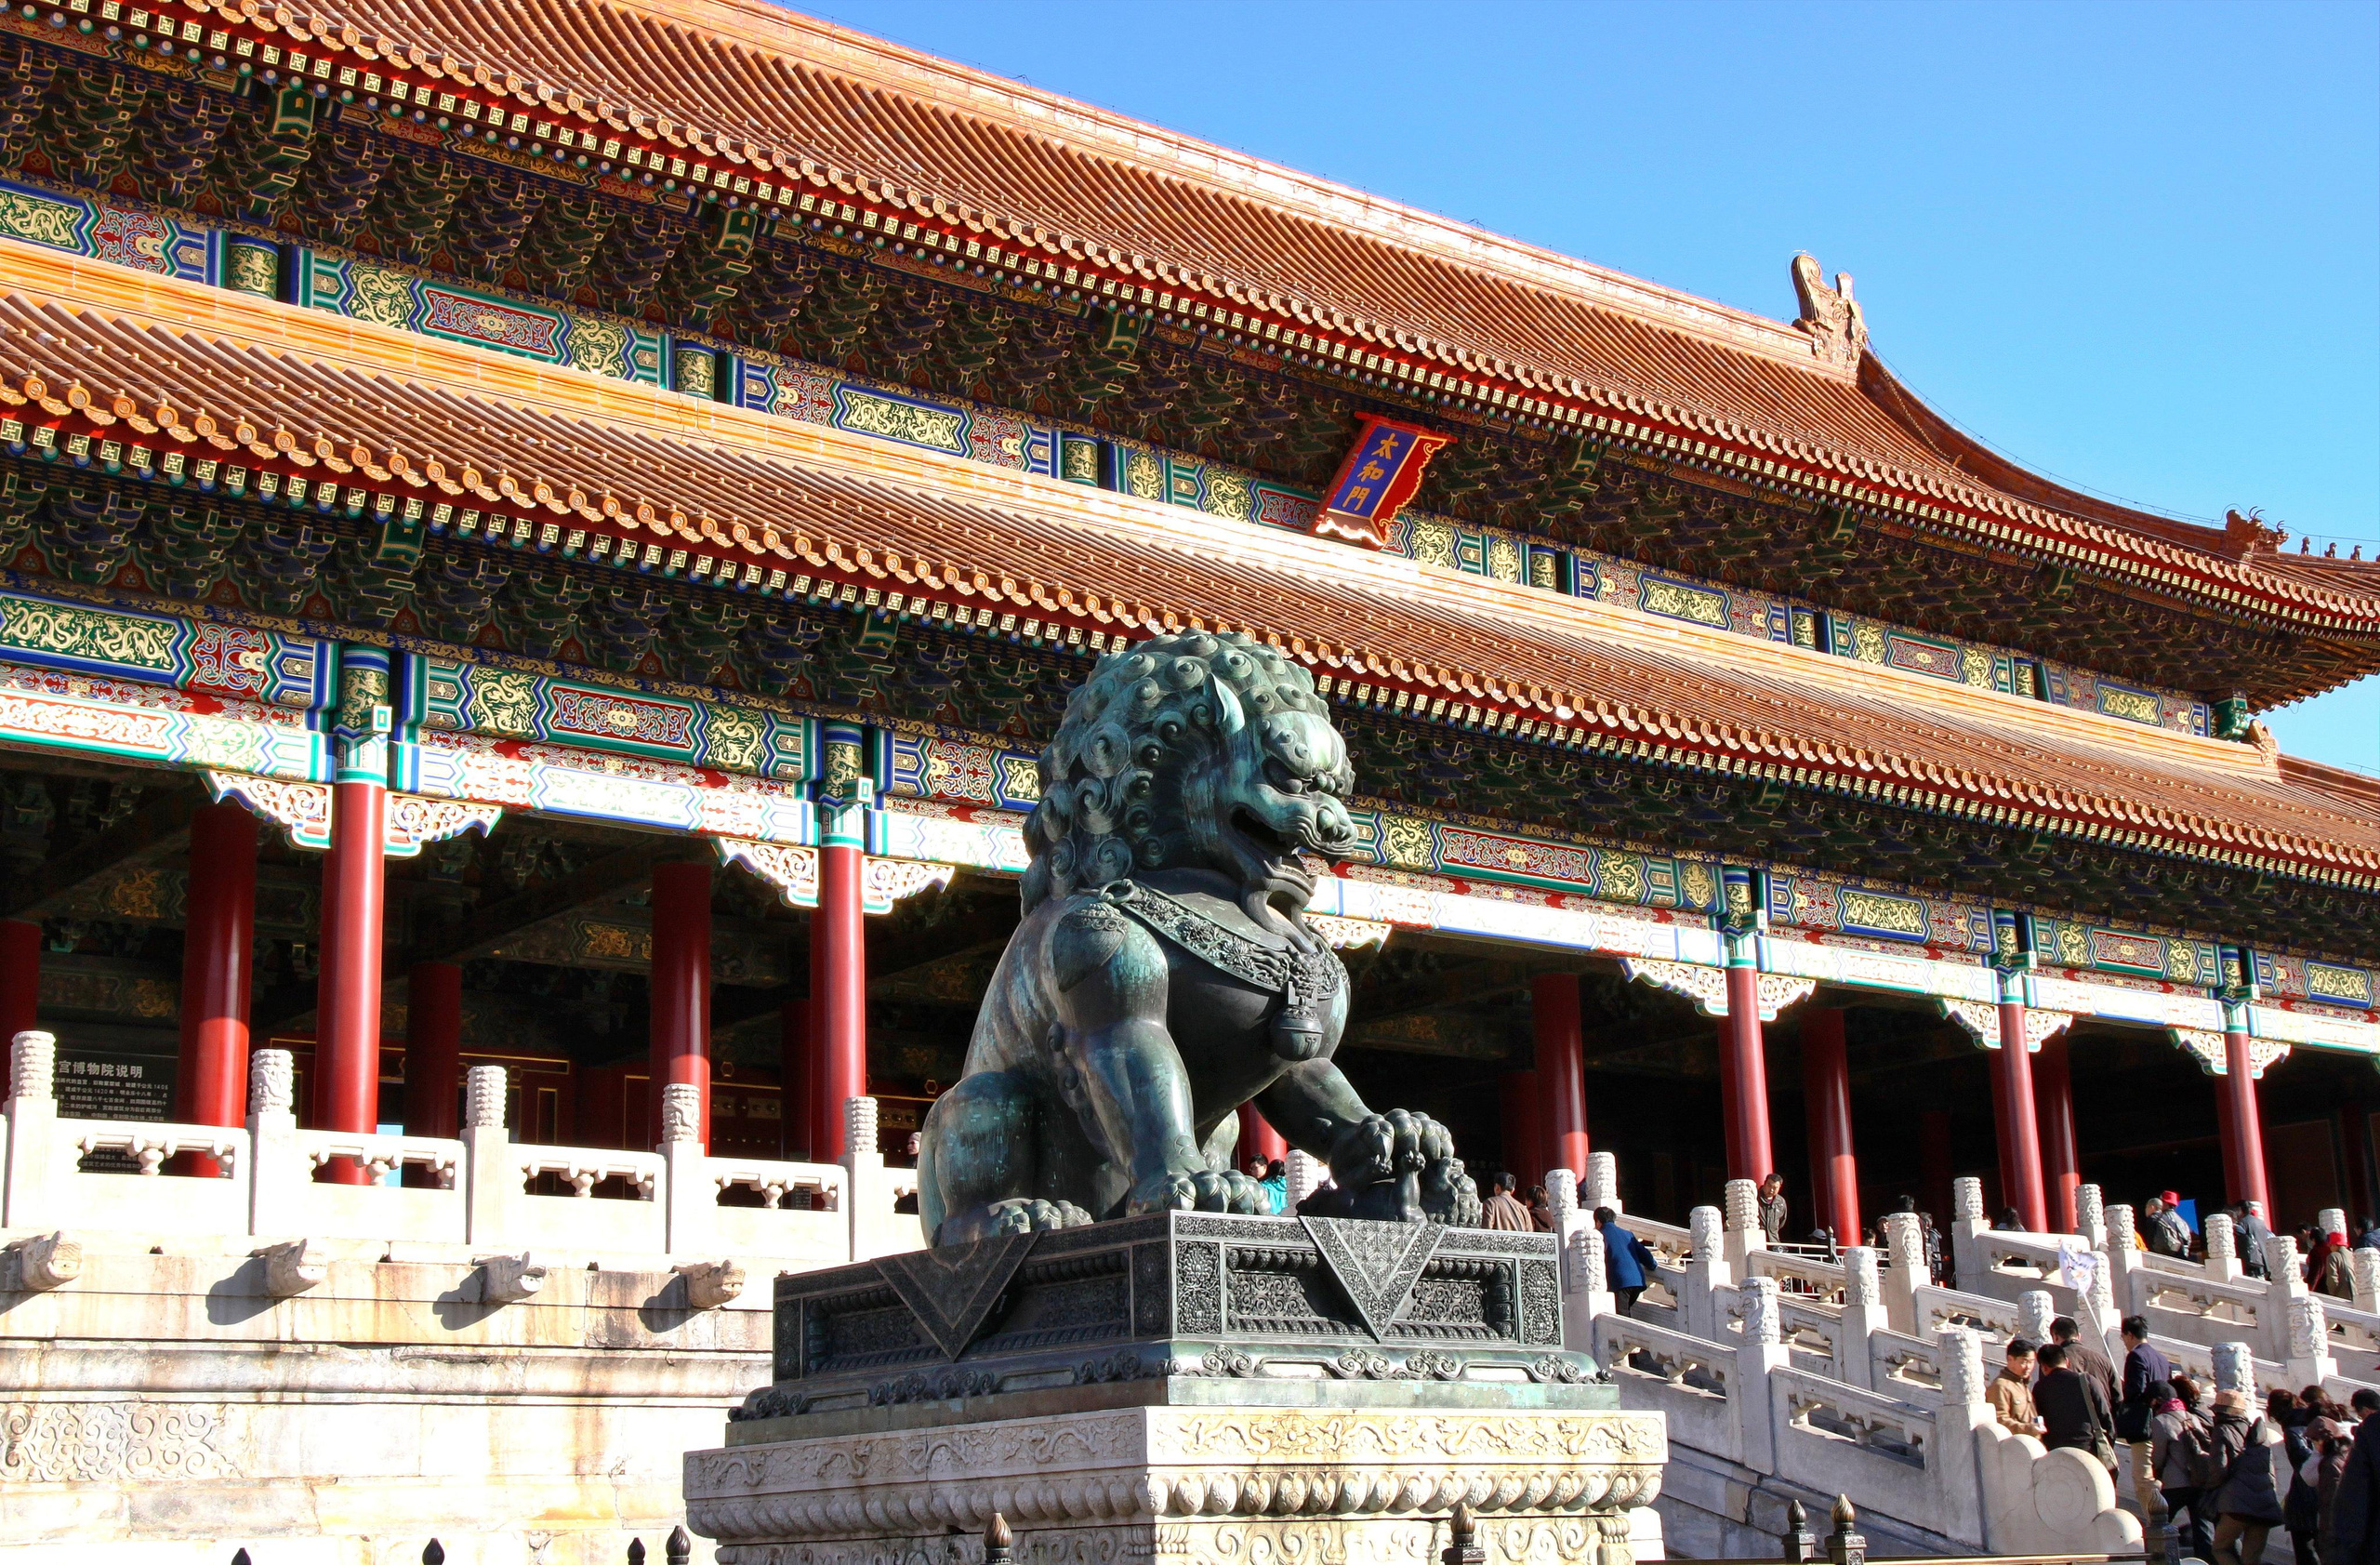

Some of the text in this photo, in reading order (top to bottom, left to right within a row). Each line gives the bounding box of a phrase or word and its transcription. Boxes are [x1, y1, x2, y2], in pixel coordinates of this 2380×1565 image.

[1342, 432, 1399, 511] 太和門
[58, 1060, 143, 1079] 宫博物院说明
